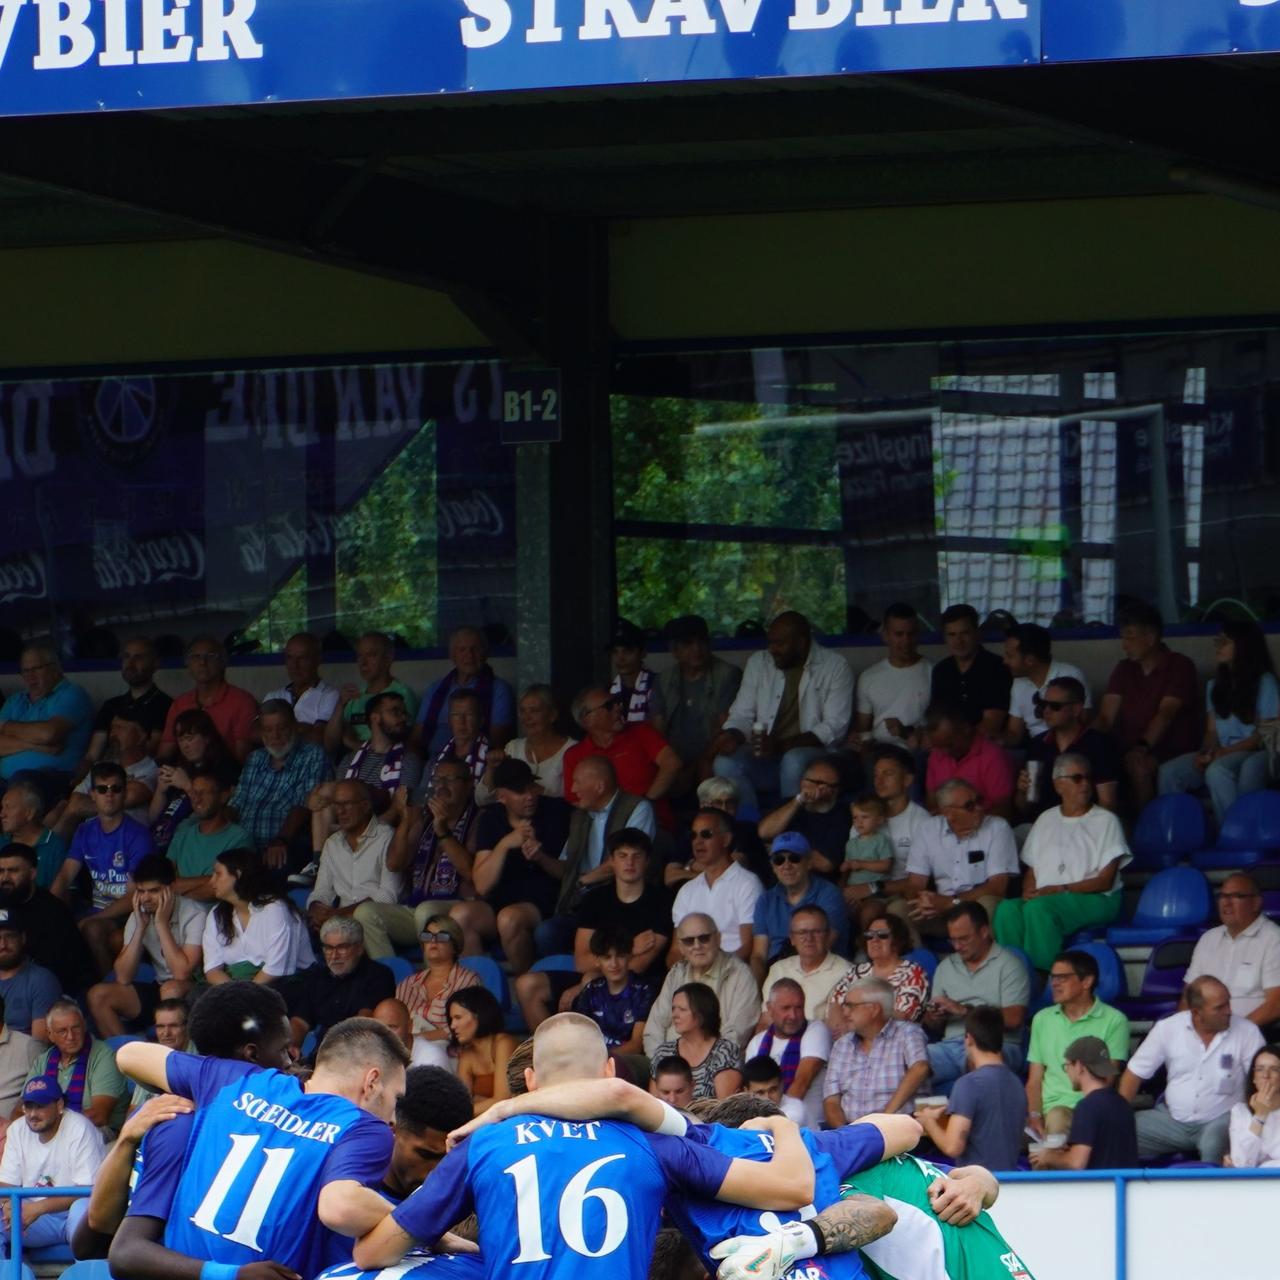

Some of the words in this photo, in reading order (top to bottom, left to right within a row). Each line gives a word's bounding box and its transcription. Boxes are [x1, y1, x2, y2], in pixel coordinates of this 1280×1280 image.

[503, 388, 557, 423] B1-2
[233, 1092, 341, 1144] SCHEIDLER
[515, 1119, 601, 1145] KVET
[190, 1134, 296, 1253] 11
[503, 1153, 630, 1265] 16
